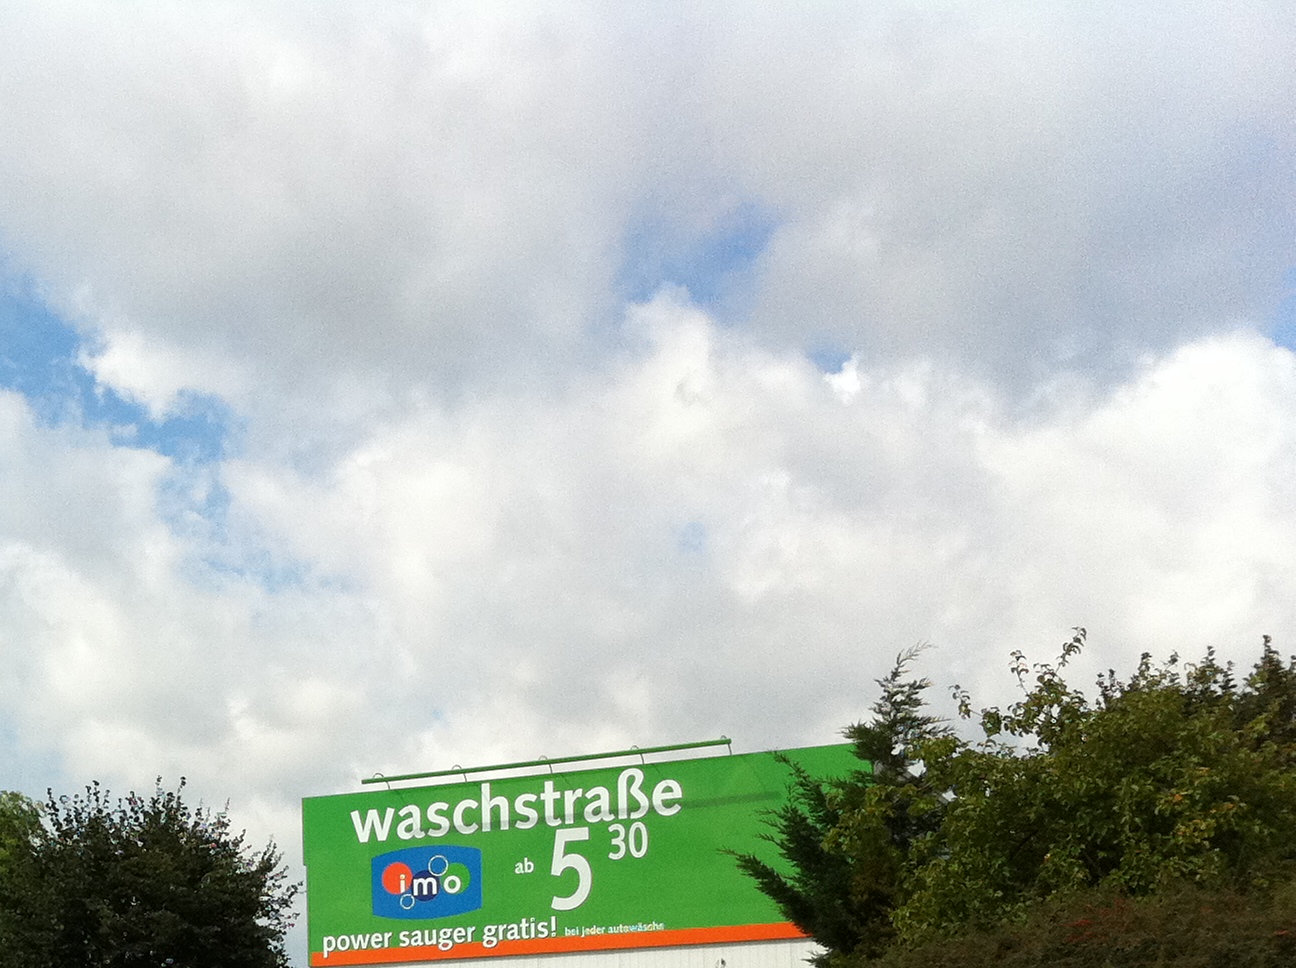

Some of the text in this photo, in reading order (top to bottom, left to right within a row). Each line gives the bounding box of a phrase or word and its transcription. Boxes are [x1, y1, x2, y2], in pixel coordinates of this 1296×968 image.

[350, 767, 683, 844] waschstraße
[399, 873, 461, 897] imo
[514, 822, 648, 911] ab 5 30
[322, 915, 665, 958] power sauger gratis! bei jeder autowäsche
